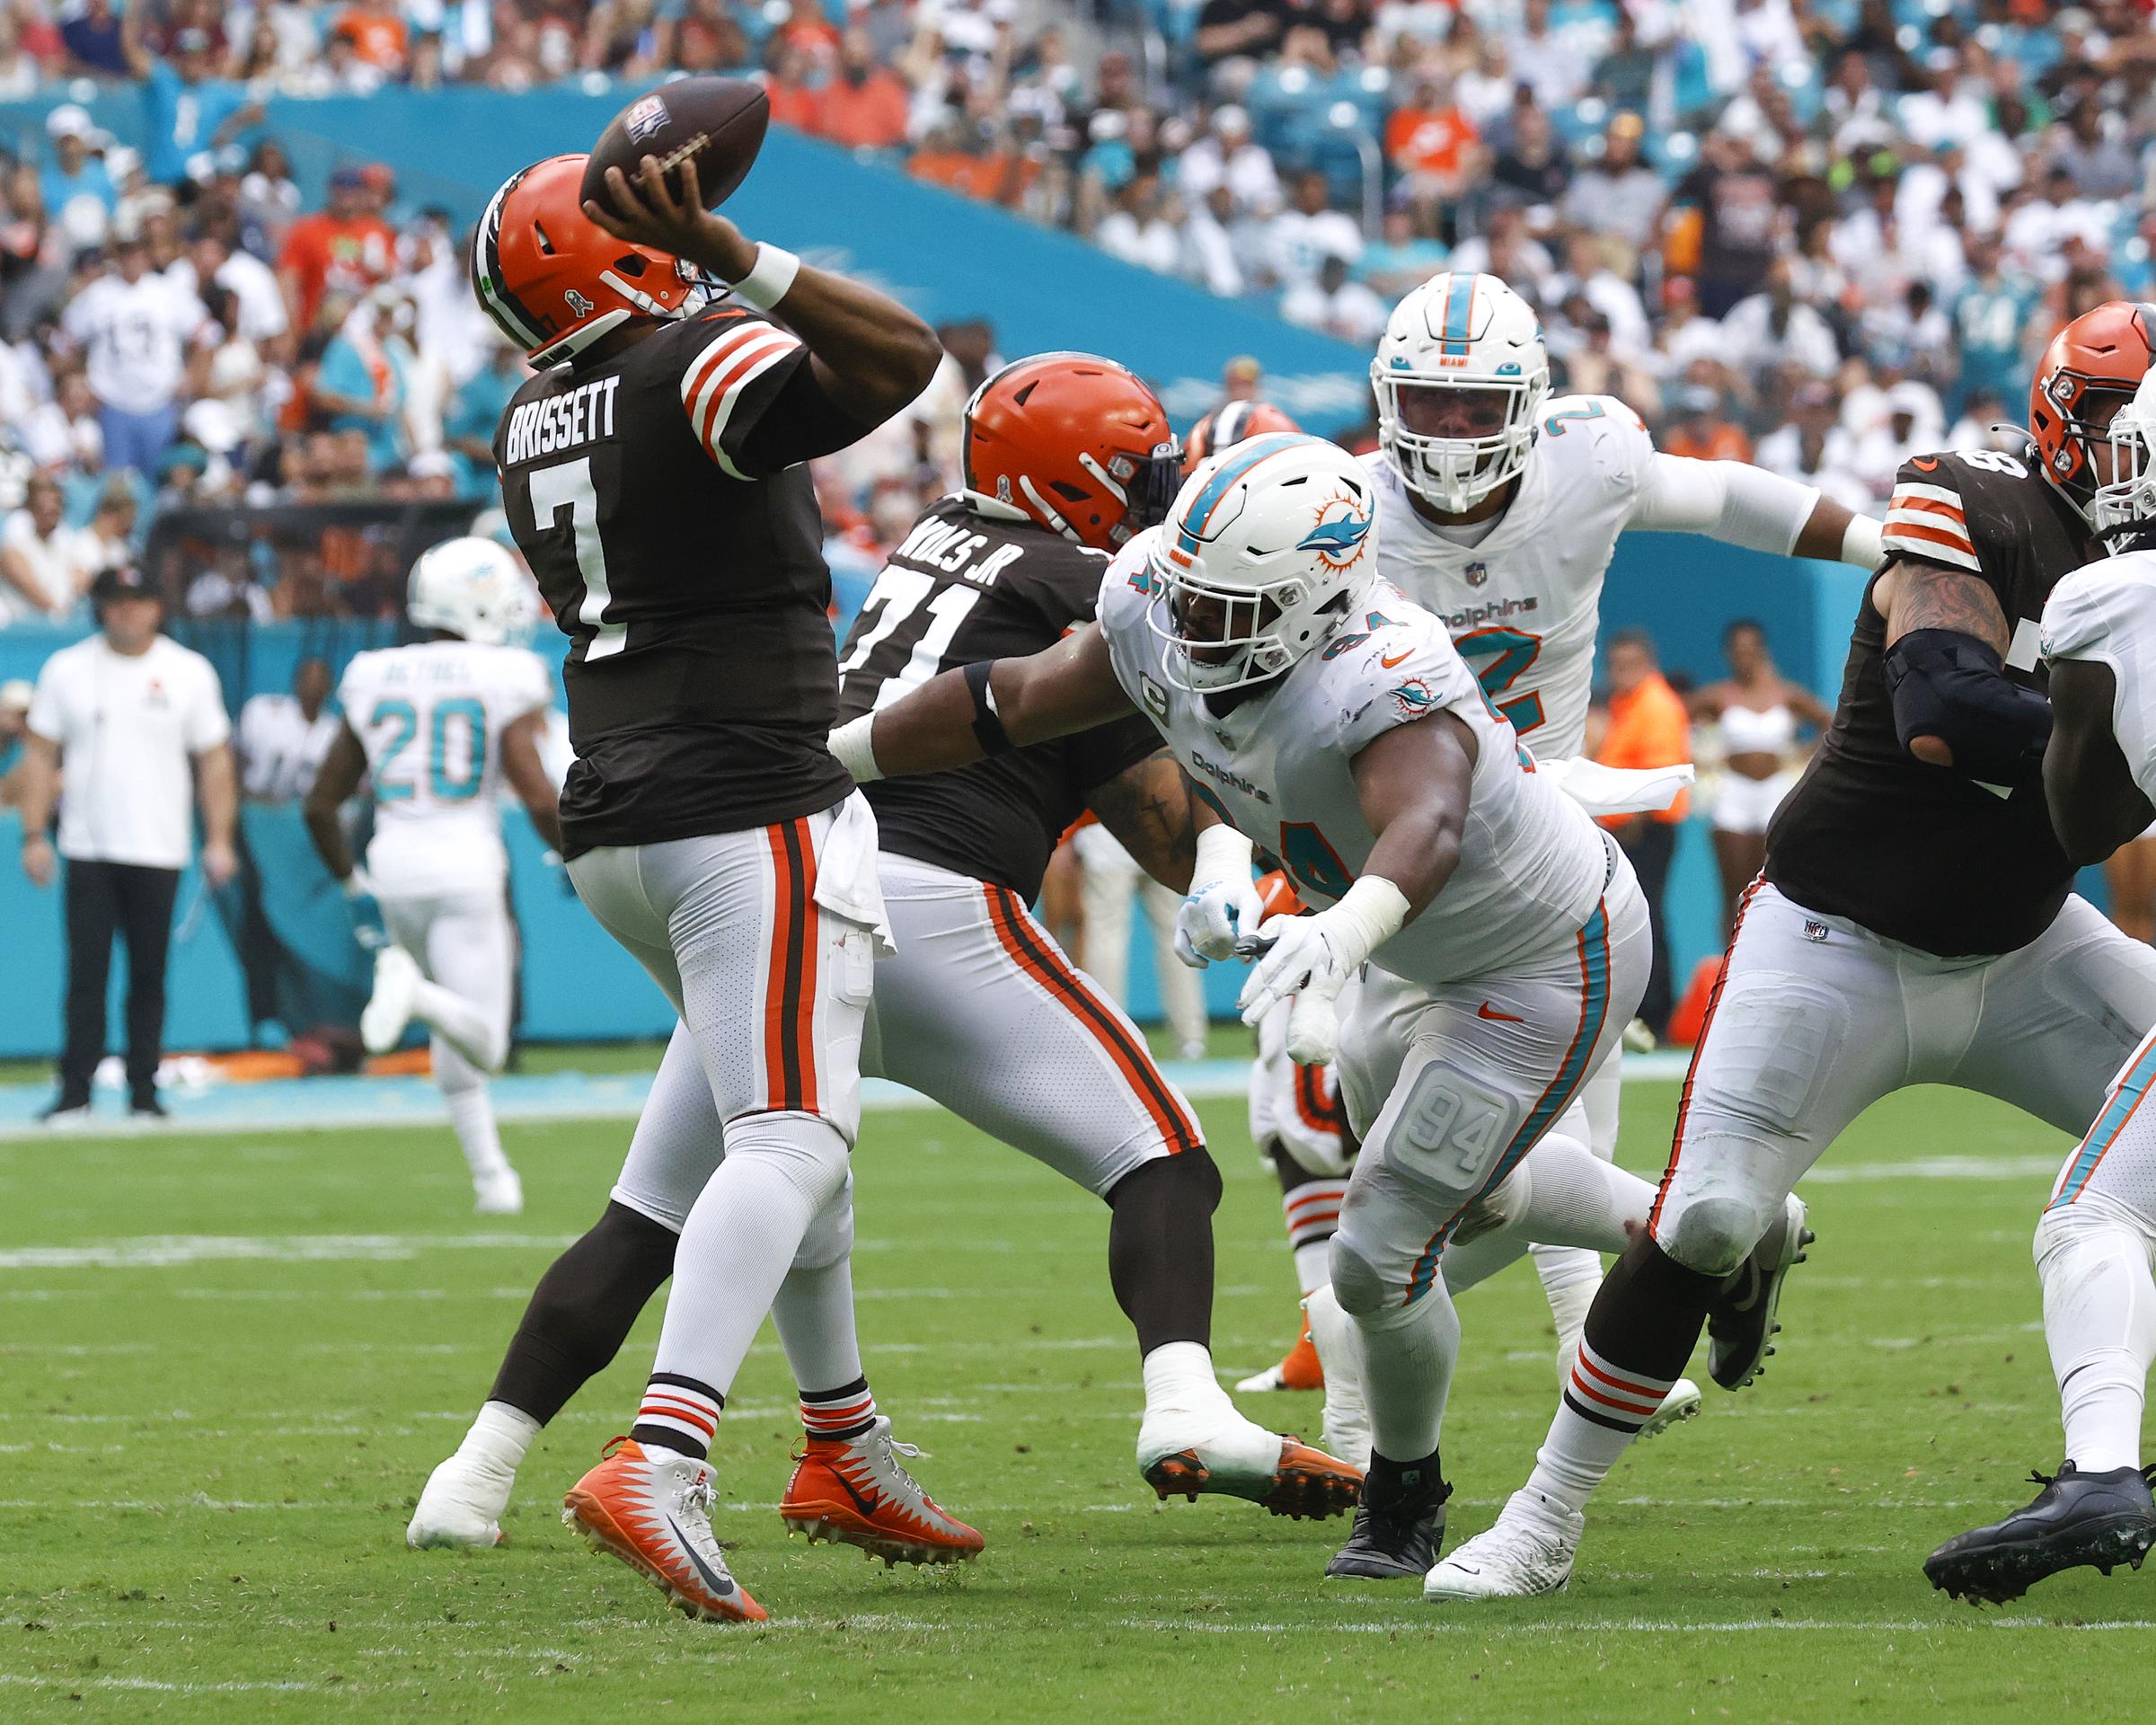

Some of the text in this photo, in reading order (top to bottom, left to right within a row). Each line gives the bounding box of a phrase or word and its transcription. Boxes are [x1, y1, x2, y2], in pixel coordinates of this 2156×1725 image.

[1439, 358, 1468, 367] MIAMI
[506, 374, 621, 465] BRISSETT
[529, 456, 627, 663] 7
[963, 543, 1025, 587] JR
[837, 563, 981, 719] 71
[1453, 625, 1547, 739] 2
[370, 695, 487, 801] 20
[1191, 749, 1272, 805] Dolphins
[1407, 1084, 1499, 1175] 94
